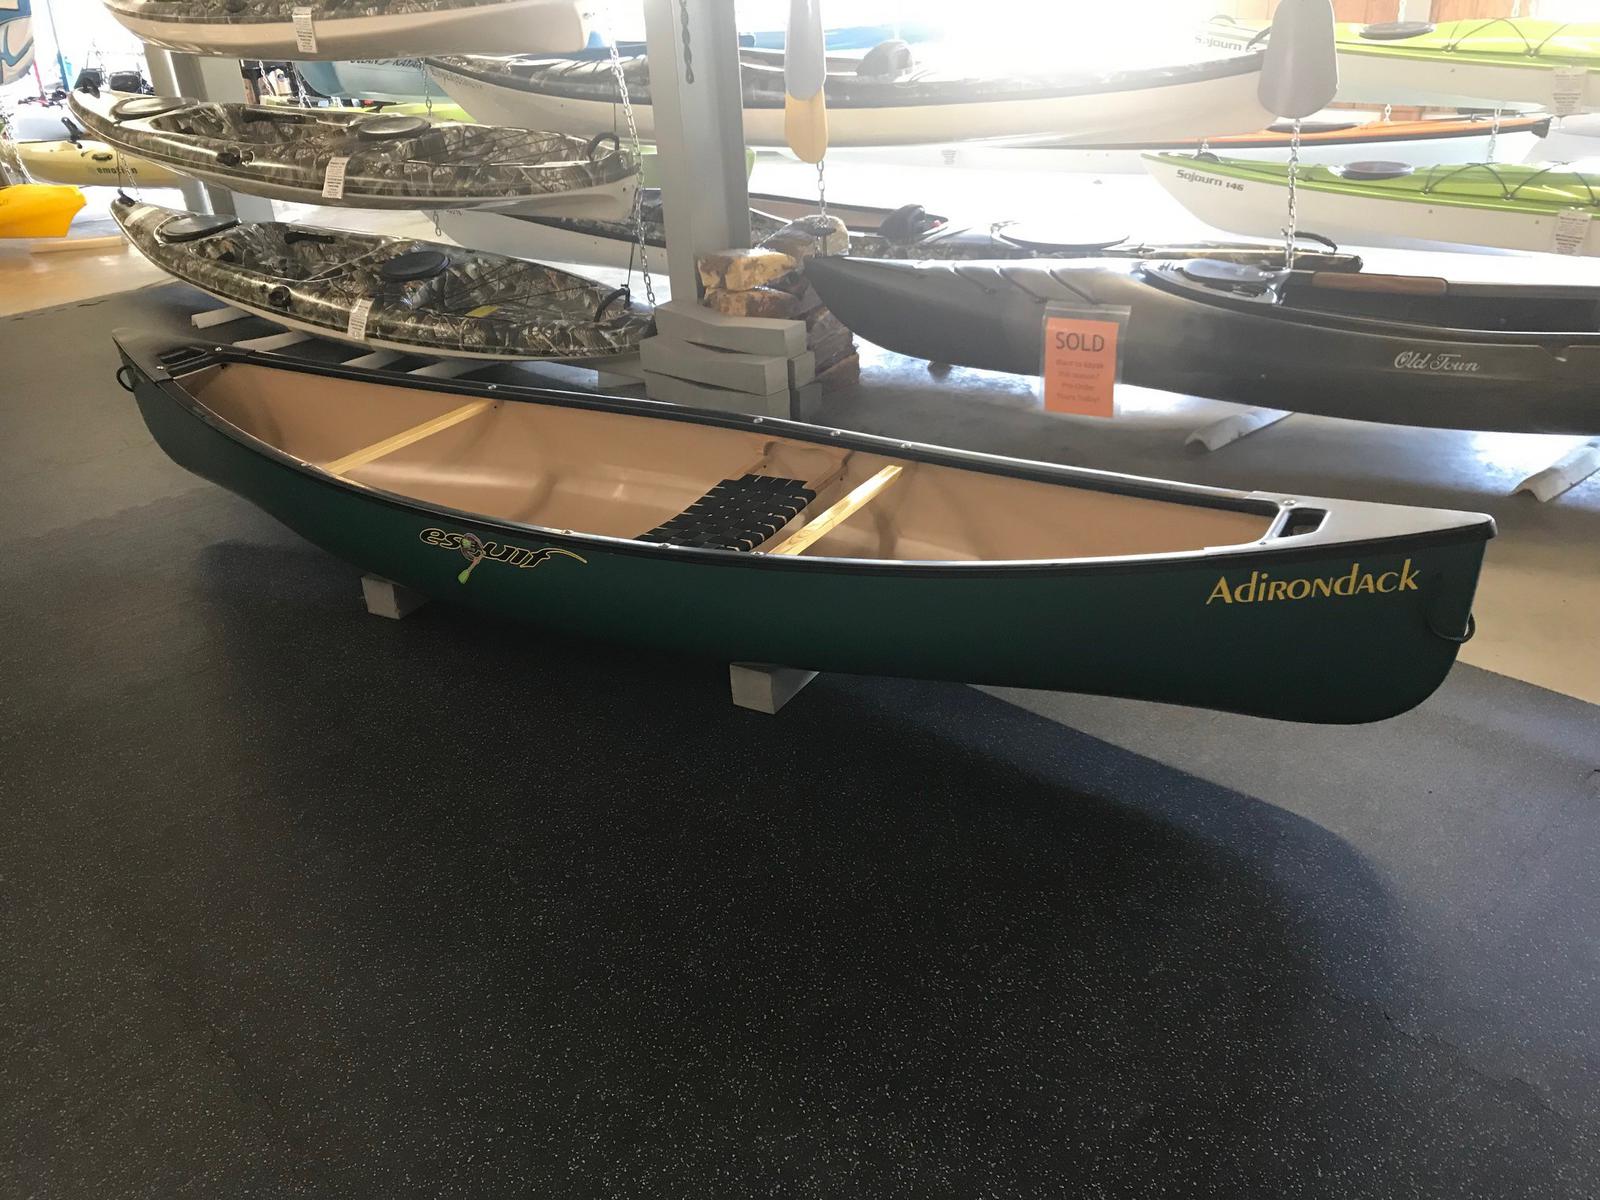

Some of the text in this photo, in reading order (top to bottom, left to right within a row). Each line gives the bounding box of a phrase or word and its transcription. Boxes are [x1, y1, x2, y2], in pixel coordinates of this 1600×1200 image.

[96, 166, 138, 175] emotin
[1176, 169, 1245, 191] Sojourn 146
[1055, 331, 1105, 353] SOLD
[1394, 351, 1480, 371] Old Town
